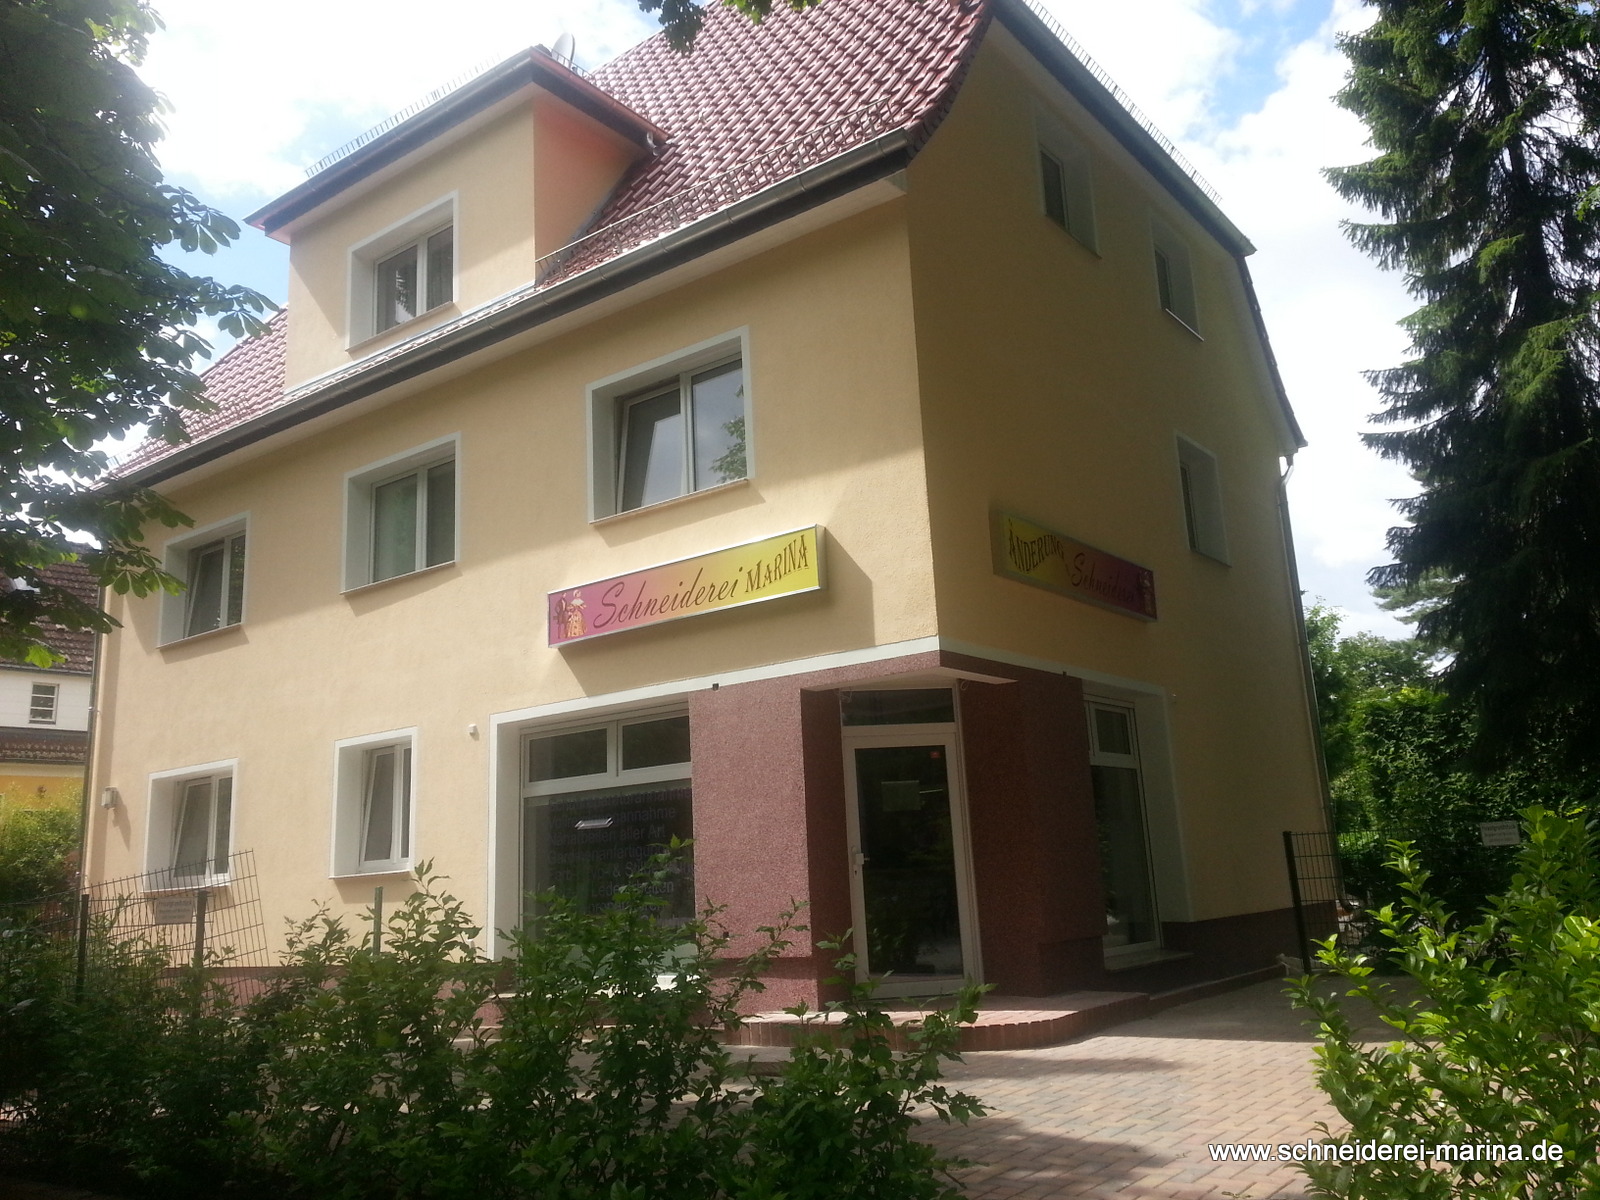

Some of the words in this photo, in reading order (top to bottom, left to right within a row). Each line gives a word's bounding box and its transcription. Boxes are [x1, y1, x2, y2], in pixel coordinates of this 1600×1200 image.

[593, 566, 743, 628] Schneiderei
[745, 534, 809, 594] MARINA
[620, 825, 645, 840] aller
[648, 823, 666, 839] Art
